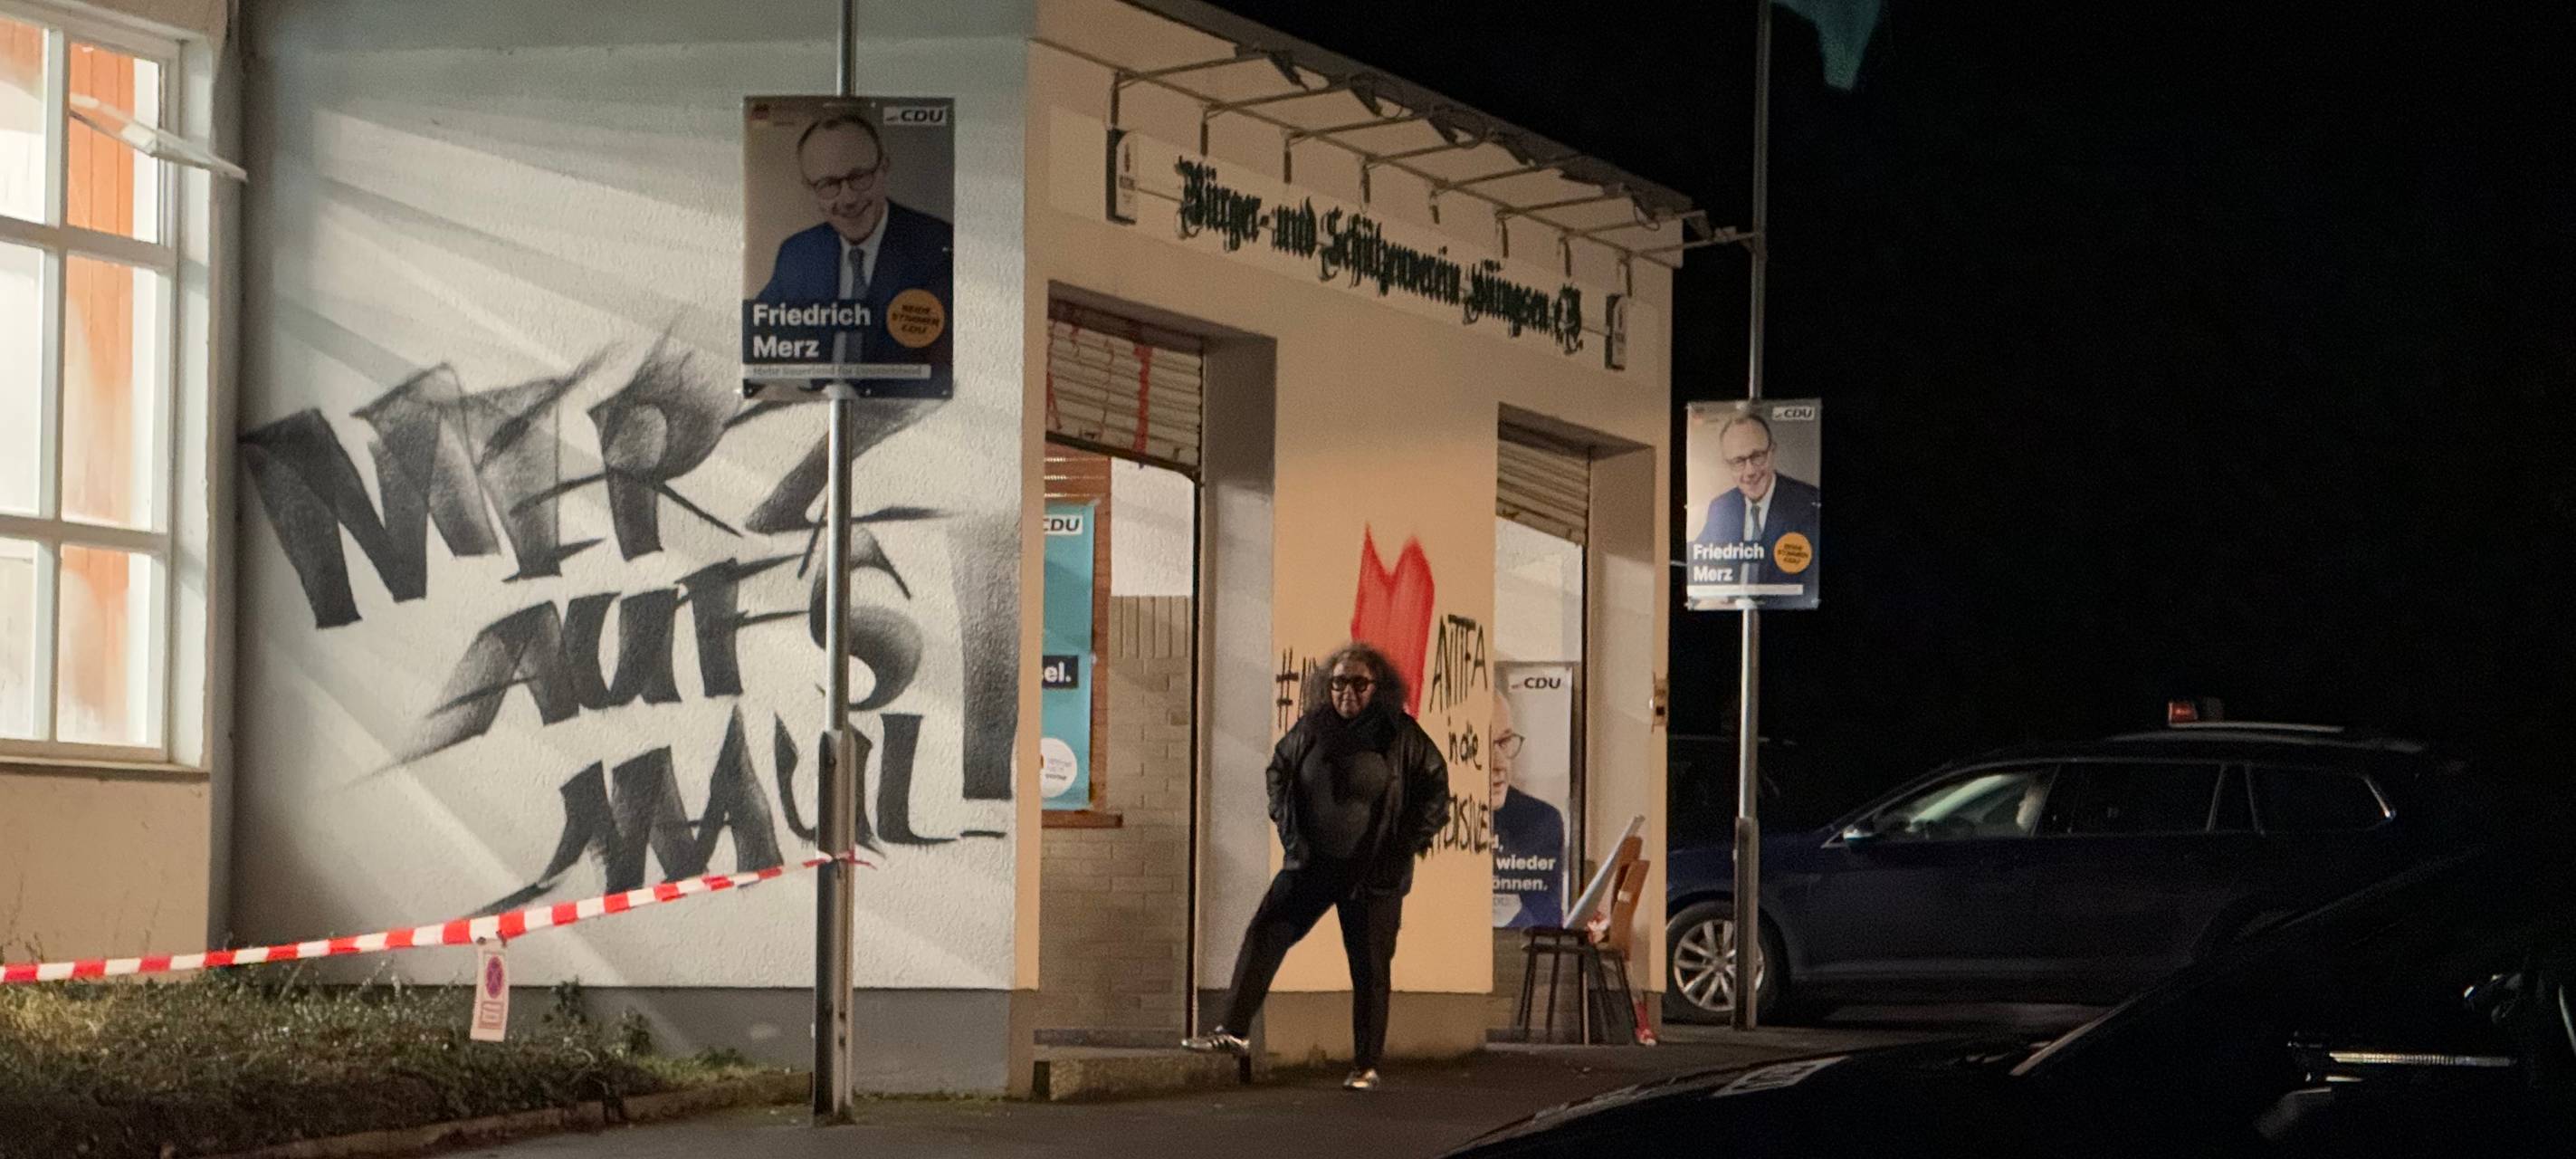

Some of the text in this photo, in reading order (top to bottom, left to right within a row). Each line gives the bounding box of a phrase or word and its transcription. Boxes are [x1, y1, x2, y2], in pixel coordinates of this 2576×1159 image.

[901, 109, 943, 123] CDU
[1271, 196, 1317, 259] und
[752, 302, 872, 327] Friedrich
[752, 335, 820, 359] Merz
[1783, 408, 1813, 419] CDU
[238, 349, 950, 628] MERZ
[1693, 541, 1765, 560] Friedrich
[1693, 565, 1733, 582] Merz
[398, 514, 924, 762] AUFS
[1428, 614, 1488, 714] ANTIFA
[1523, 676, 1562, 690] CDU
[1495, 854, 1557, 871] wieder
[1492, 875, 1550, 891] önnen.
